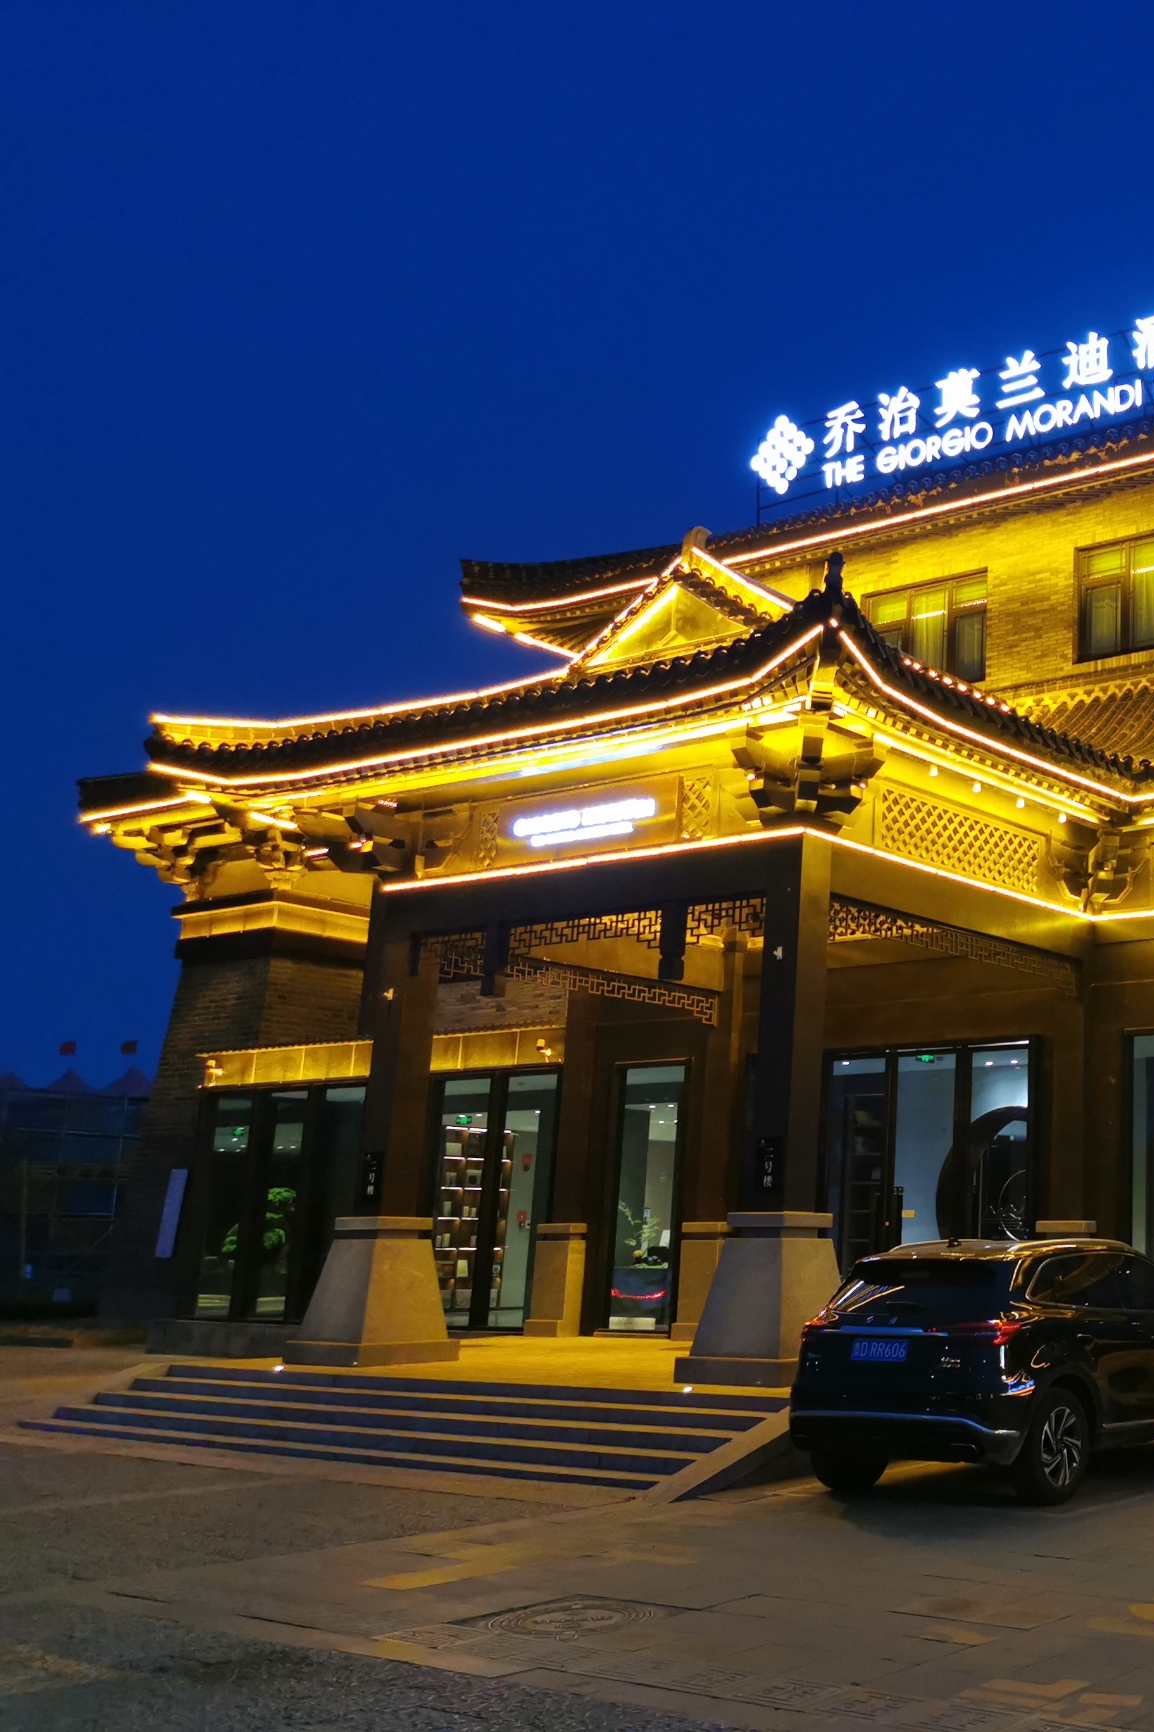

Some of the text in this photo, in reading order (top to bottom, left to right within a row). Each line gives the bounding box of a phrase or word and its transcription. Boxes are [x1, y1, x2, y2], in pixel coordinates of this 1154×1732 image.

[822, 456, 865, 489] THE
[876, 420, 994, 474] GIORGIO
[1004, 379, 1143, 442] MORANDI
